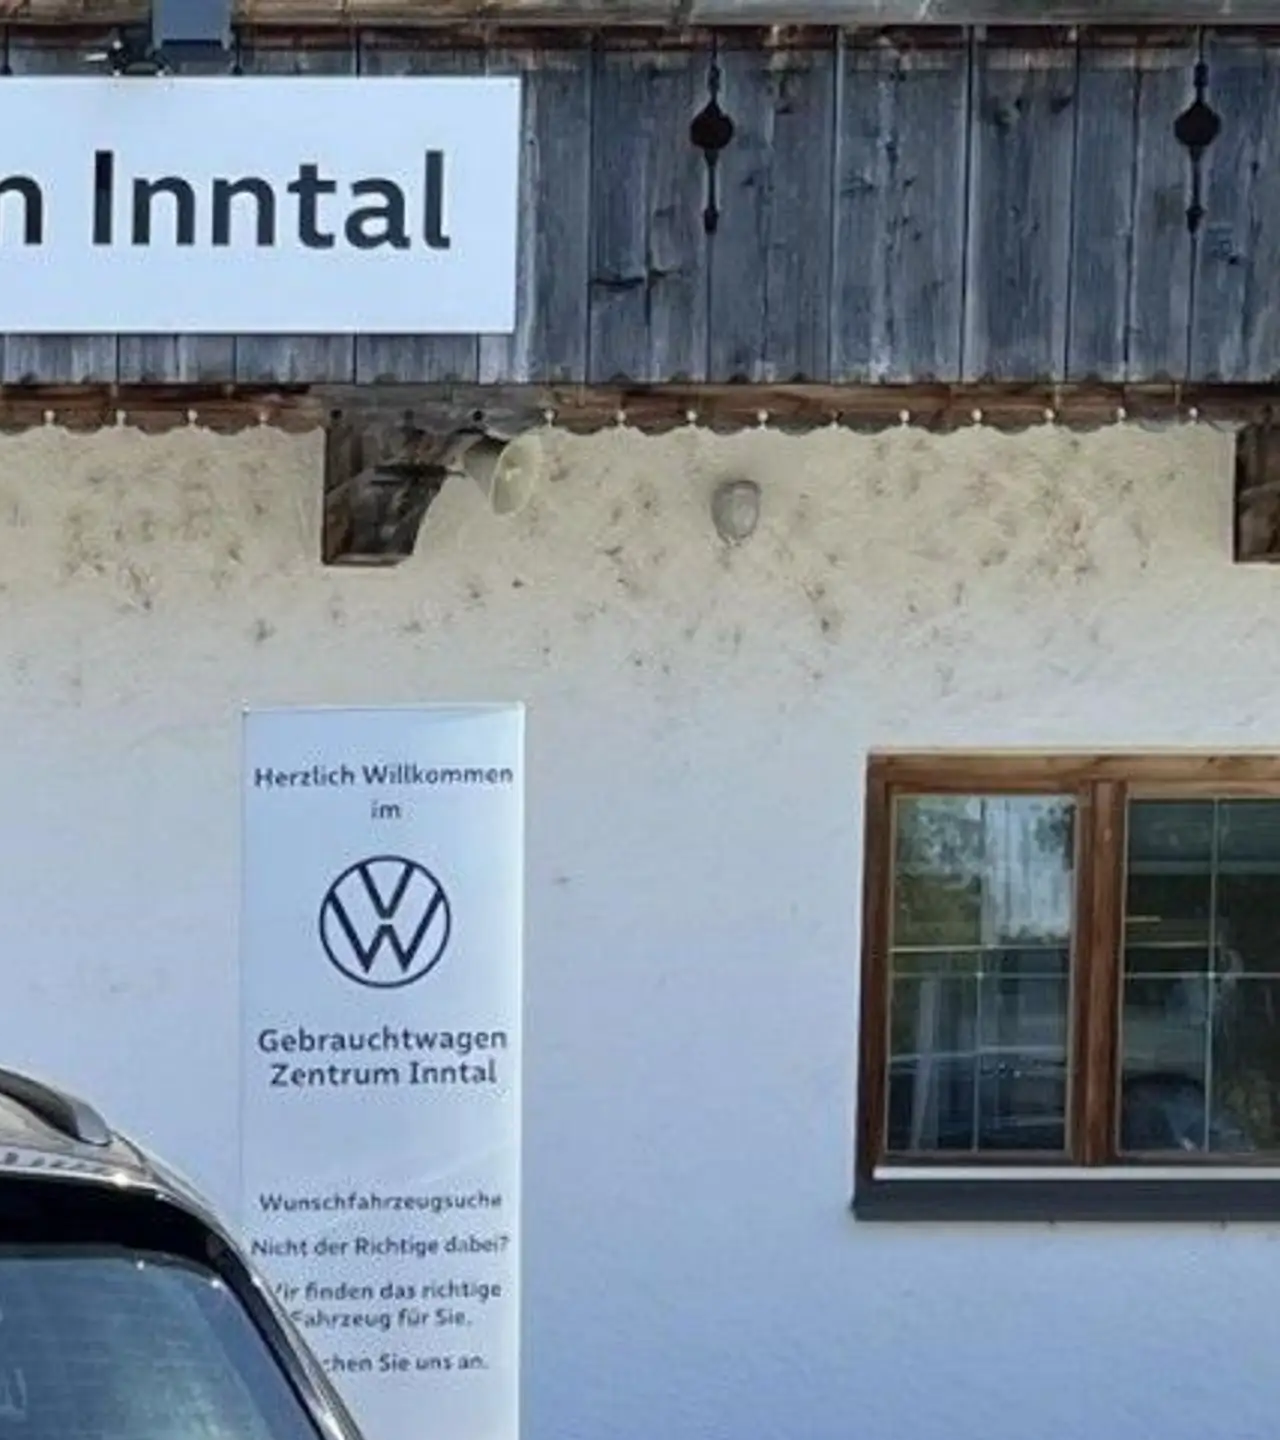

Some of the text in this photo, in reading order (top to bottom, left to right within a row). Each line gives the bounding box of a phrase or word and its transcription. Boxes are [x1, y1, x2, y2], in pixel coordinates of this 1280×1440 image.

[92, 149, 451, 249] Inntal
[253, 762, 514, 788] Herzlich Willkommen
[370, 800, 401, 819] im
[258, 1026, 507, 1054] Gebrauchtwagen
[269, 1060, 497, 1087] Zentrum Inntal
[259, 1190, 502, 1213] Wunschfahrzeugsuche
[250, 1235, 510, 1258] Nicht der Richtige dabei?
[304, 1282, 373, 1301] finden
[379, 1282, 416, 1300] das
[421, 1280, 502, 1303] richtige
[397, 1308, 429, 1327] für
[434, 1309, 473, 1327] Sie.
[378, 1353, 411, 1372] Sie
[415, 1356, 453, 1371] uns
